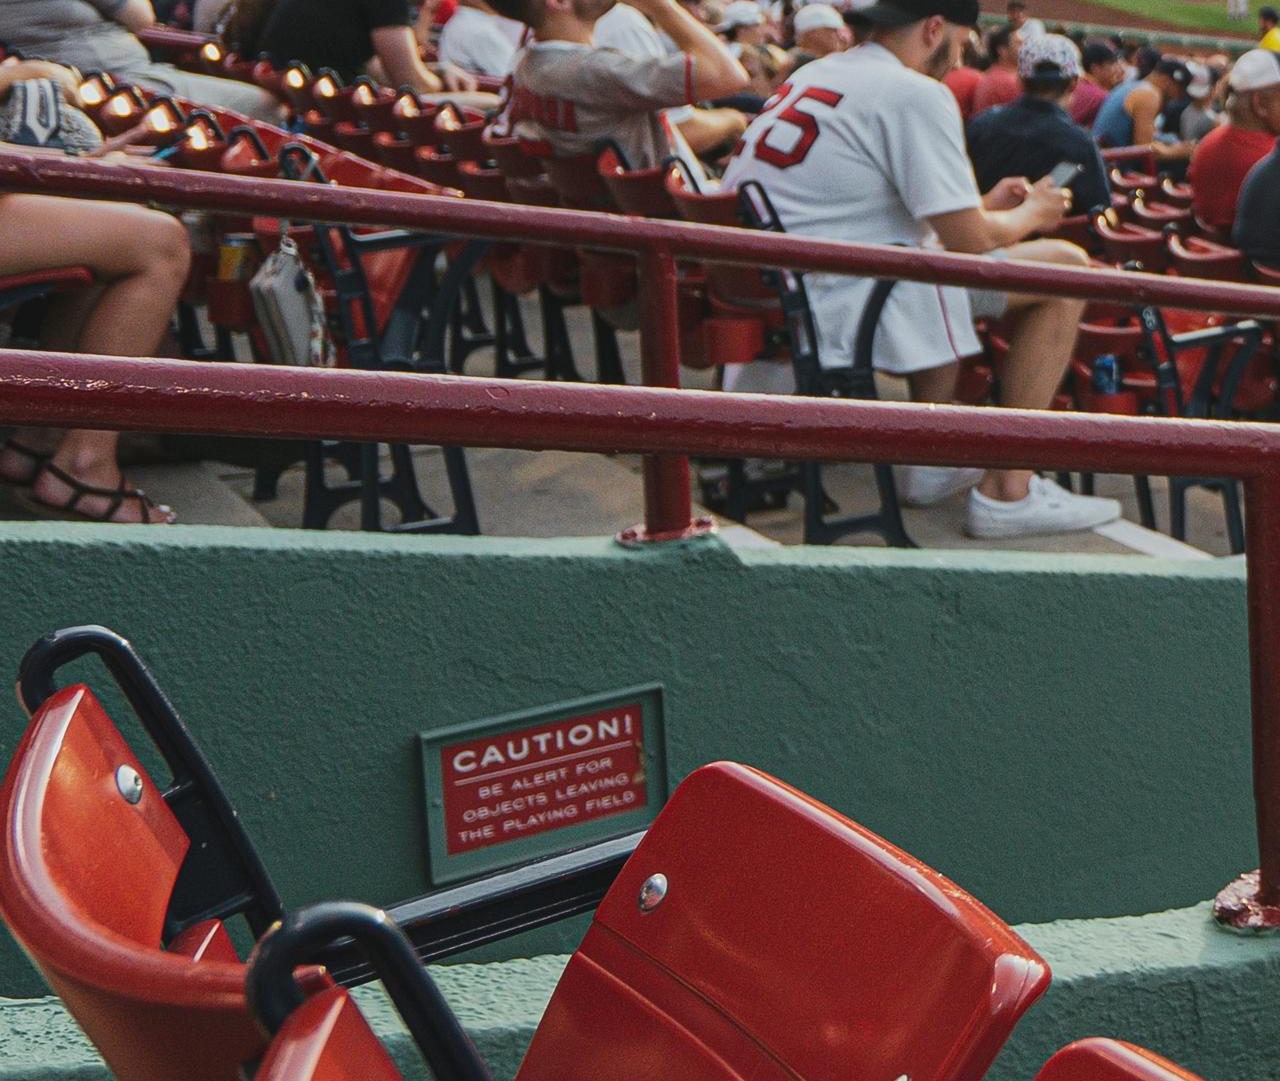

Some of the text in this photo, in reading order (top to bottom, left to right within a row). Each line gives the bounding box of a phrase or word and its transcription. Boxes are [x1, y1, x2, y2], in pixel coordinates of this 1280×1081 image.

[452, 713, 633, 773] CAUTION!
[462, 772, 630, 824] OBJECTS LEAVING
[478, 757, 613, 800] BE ALERT FOR
[458, 790, 636, 843] THE PLAYING FIELD
